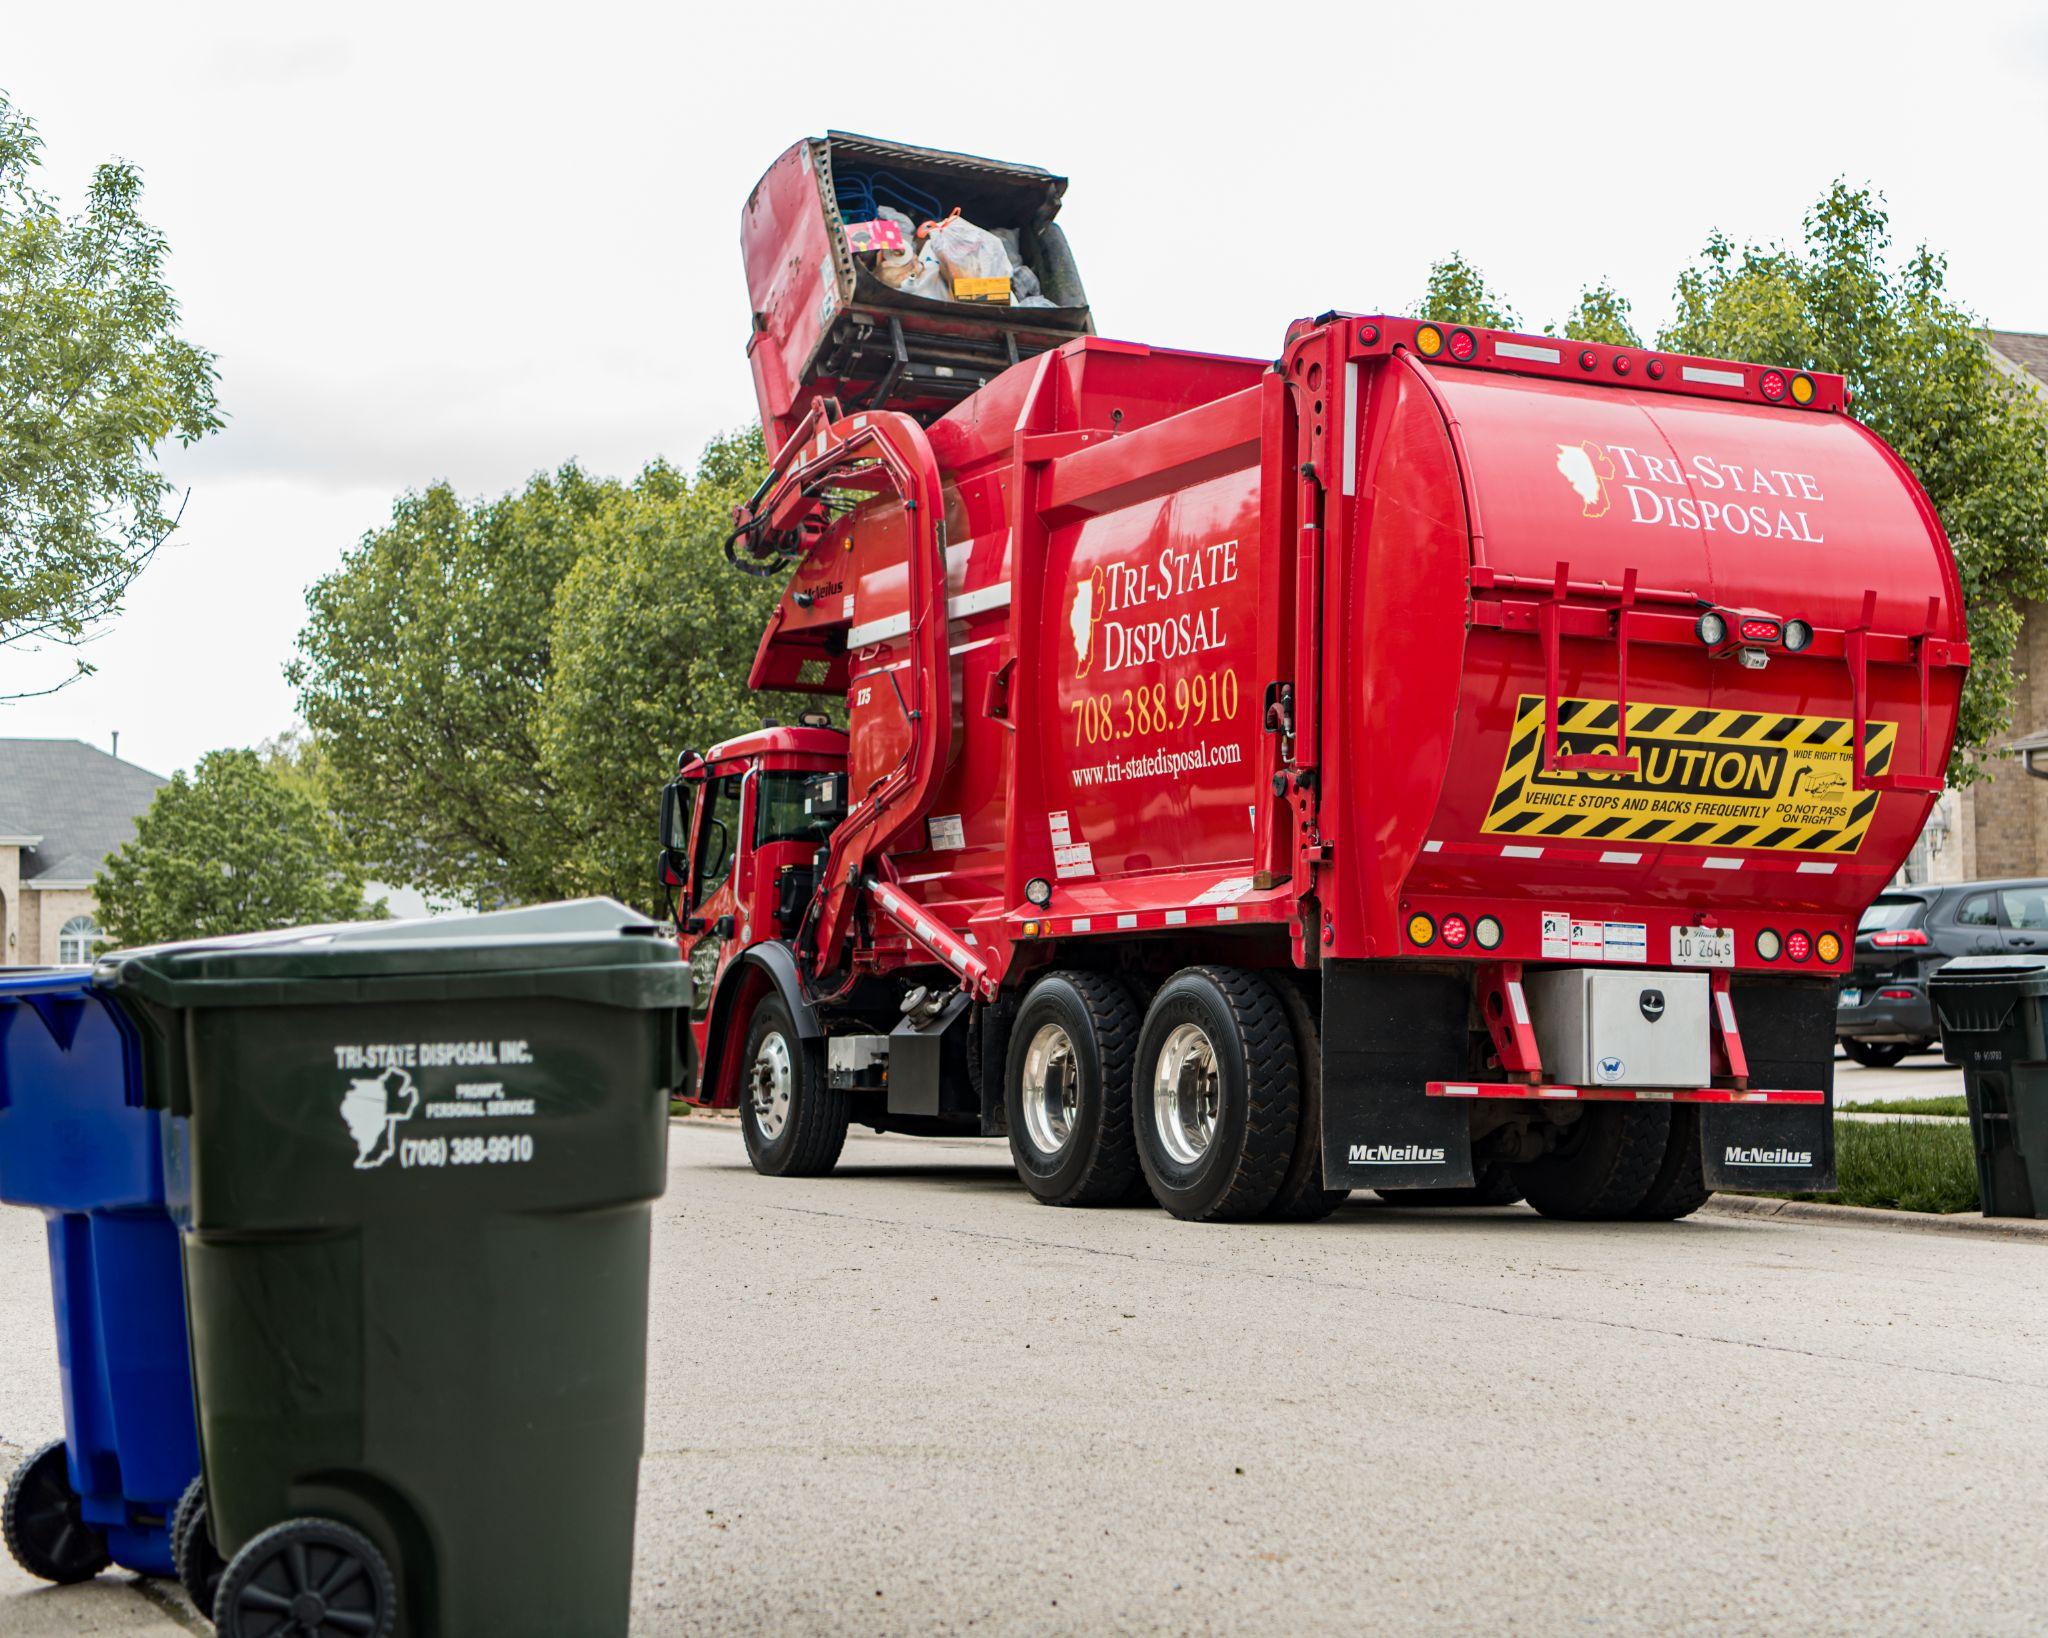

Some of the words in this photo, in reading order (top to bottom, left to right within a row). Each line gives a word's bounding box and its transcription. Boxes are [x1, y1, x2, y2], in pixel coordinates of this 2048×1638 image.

[1606, 444, 1824, 501] TRI-STATE
[1622, 484, 1824, 543] DISPOSAL
[1106, 539, 1239, 612] TRI-STATE
[1104, 606, 1227, 672] DISPOSAL
[856, 687, 872, 706] 175
[1070, 668, 1238, 747] 708.388.9910
[1072, 740, 1242, 787] www.tri-statedisposal.com
[1793, 750, 1813, 759] WIDE
[1814, 751, 1837, 761] RIGHT
[1525, 791, 1577, 807] VEHICLE
[1579, 794, 1619, 809] STOPS
[1621, 797, 1649, 811] AND
[1651, 799, 1691, 814] BACKS
[1694, 802, 1771, 819] FREQUENTLY
[1776, 803, 1793, 813] DO
[1795, 804, 1818, 815] NOT
[1819, 805, 1848, 816] PASS
[1782, 813, 1799, 823] ON
[1800, 815, 1834, 825] RIGHT
[1678, 939, 1692, 957] 10
[1699, 939, 1721, 958] 264
[334, 1043, 416, 1069] TRI-STATE
[419, 1041, 497, 1067] DISPOSAL
[499, 1040, 534, 1064] INC.
[425, 1102, 485, 1119] PERSONAL
[487, 1099, 536, 1116] SERVICE
[400, 1137, 447, 1168] (708)
[450, 1135, 534, 1165] 388-9910
[1348, 1144, 1445, 1161] McNeilus
[1725, 1146, 1812, 1163] McNeilus
